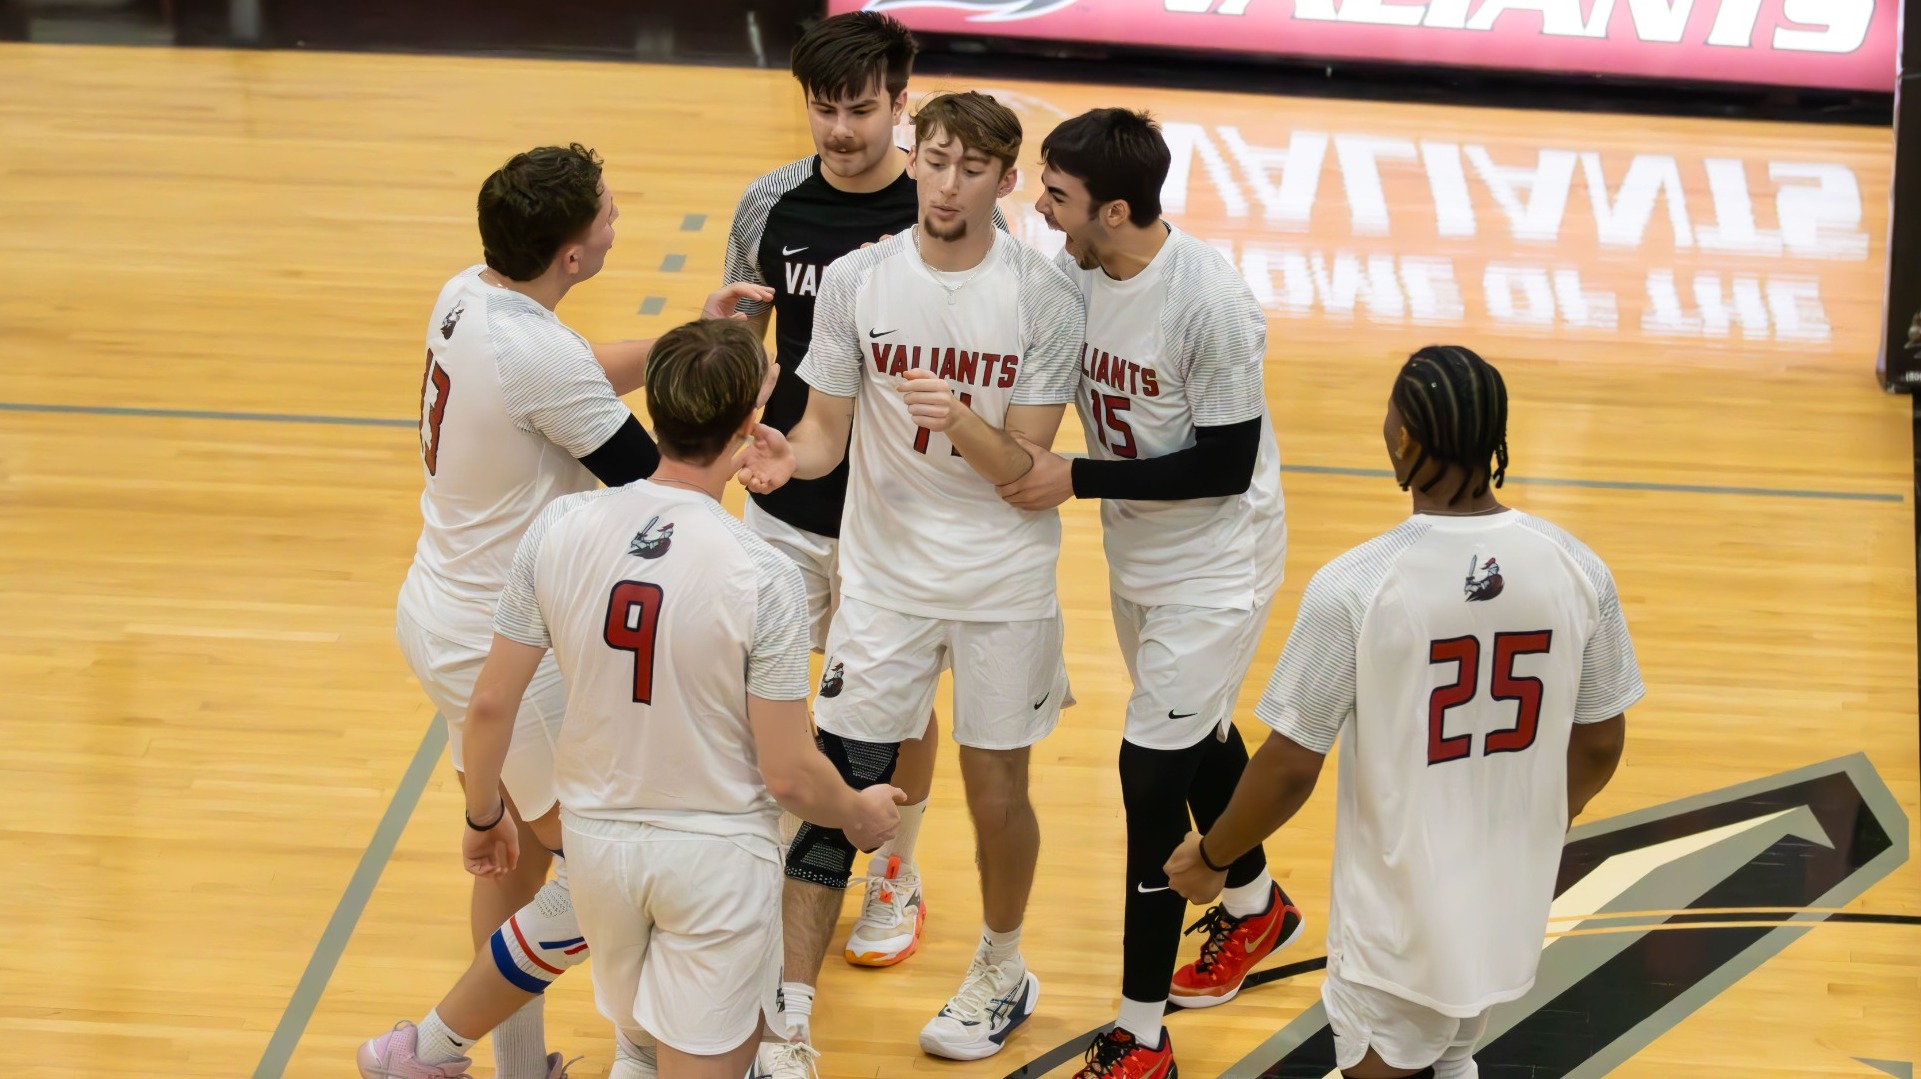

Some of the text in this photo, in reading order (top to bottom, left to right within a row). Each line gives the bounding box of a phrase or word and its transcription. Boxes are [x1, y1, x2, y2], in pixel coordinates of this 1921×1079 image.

[785, 262, 829, 297] VA
[1081, 342, 1160, 397] LIANTS
[1090, 388, 1138, 459] 15
[603, 579, 664, 706] 9
[1427, 629, 1553, 766] 25
